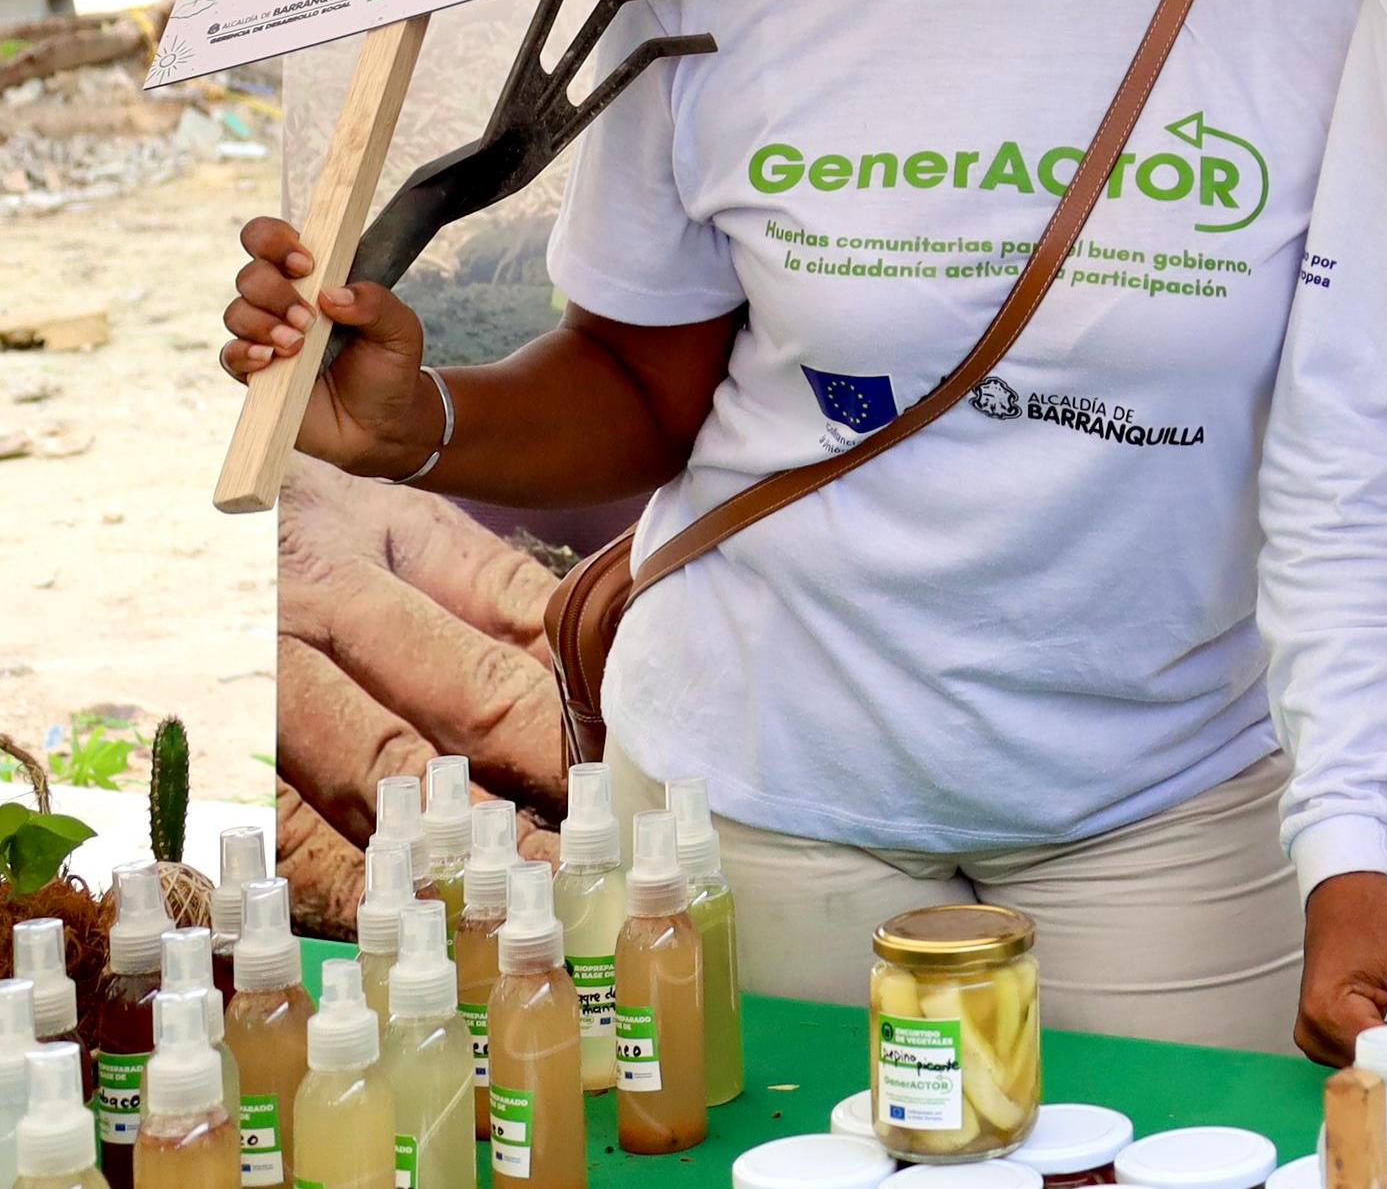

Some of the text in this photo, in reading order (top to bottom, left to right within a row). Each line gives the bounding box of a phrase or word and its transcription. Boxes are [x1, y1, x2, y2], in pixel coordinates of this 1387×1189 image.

[765, 219, 829, 248] Huertas
[836, 236, 993, 253] comunitarias
[1088, 241, 1146, 264] buen
[1153, 248, 1252, 277] gobierno,
[1311, 255, 1337, 269] por
[784, 250, 801, 271] la
[806, 257, 937, 278] ciudadanía
[944, 262, 1020, 278] activa
[1070, 269, 1228, 298] participación
[1028, 392, 1135, 424] ALCALDÍA DE
[1028, 403, 1204, 446] BARRANQUILLA
[916, 1058, 960, 1077] picante
